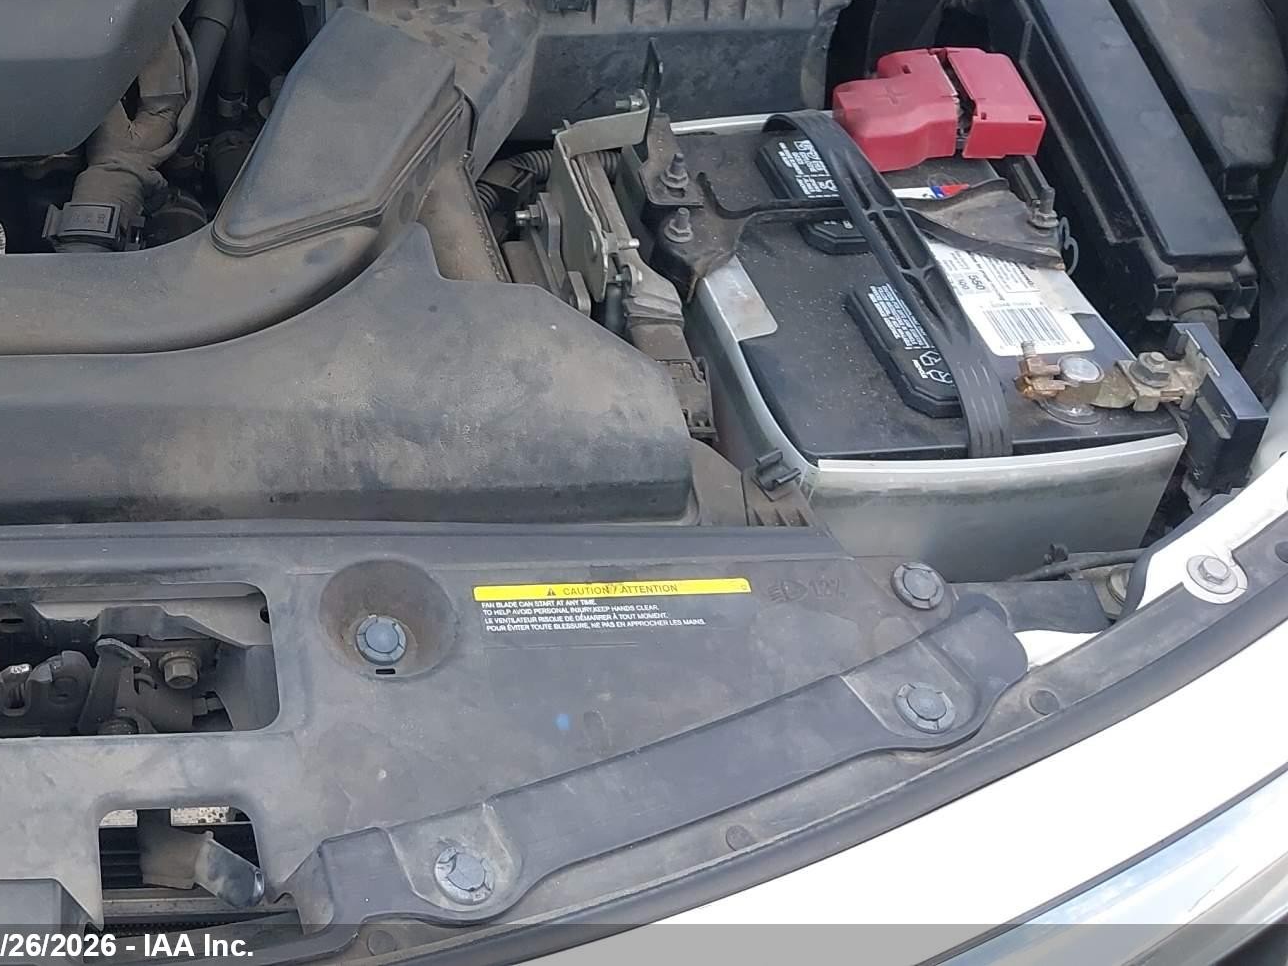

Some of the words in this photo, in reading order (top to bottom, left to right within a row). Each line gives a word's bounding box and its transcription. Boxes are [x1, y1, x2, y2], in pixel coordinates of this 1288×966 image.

[562, 585, 610, 596] CAUTION
[620, 584, 678, 595] ATTENTION
[495, 601, 518, 609] BLADE
[533, 607, 570, 615] PERSONAL
[494, 616, 538, 624] VENTILATEUR
[538, 615, 564, 623] RISQUE
[618, 612, 636, 620] TOUT
[507, 623, 530, 632] ÉVITER
[530, 623, 553, 631] TOUTE
[616, 620, 626, 628] EN
[626, 619, 669, 627] APPROCHER
